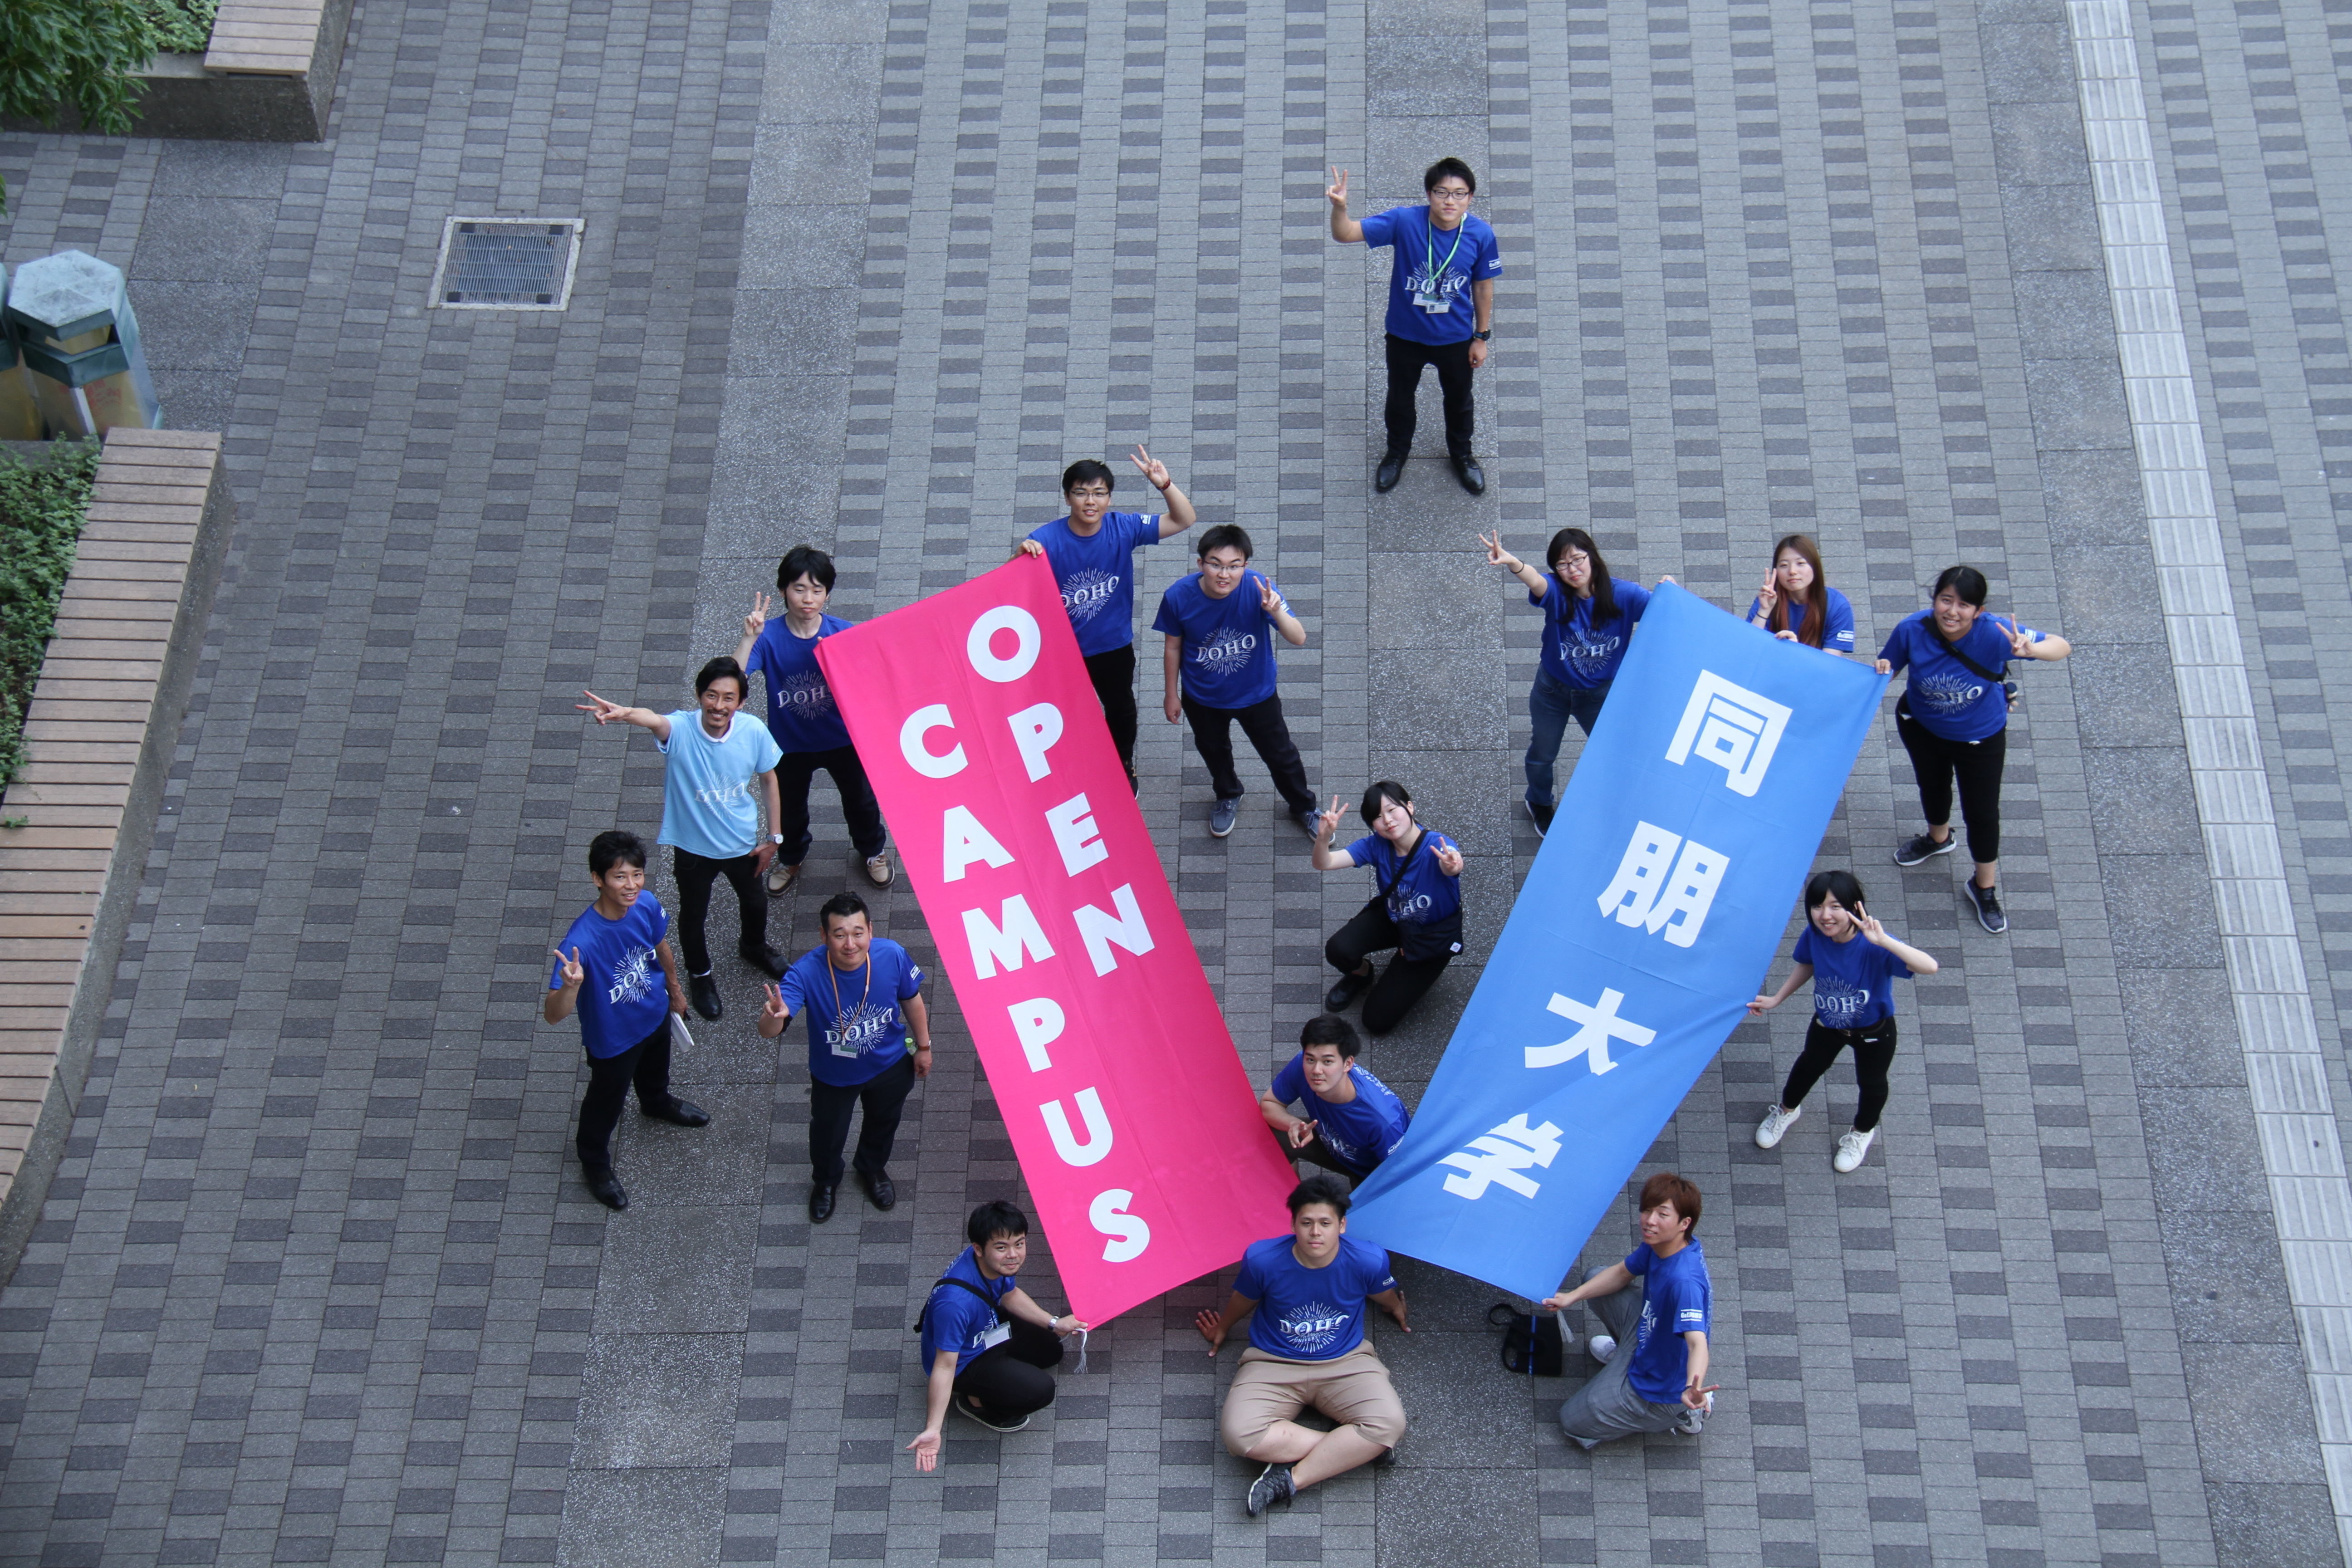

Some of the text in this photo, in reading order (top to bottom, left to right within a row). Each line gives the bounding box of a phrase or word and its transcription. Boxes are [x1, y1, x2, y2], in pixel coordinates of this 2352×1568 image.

[1405, 275, 1468, 294] DOHO
[1196, 634, 1257, 663] DOHO
[1559, 636, 1621, 661] DOHO
[777, 685, 829, 708] DOH
[1924, 686, 1983, 704] OHO
[966, 605, 1155, 977] OPEN
[1439, 669, 1793, 1200] 同朋大学
[899, 703, 1151, 1263] CAMPUS
[1815, 990, 1870, 1013] DOHO
[824, 1008, 893, 1043] DOHO
